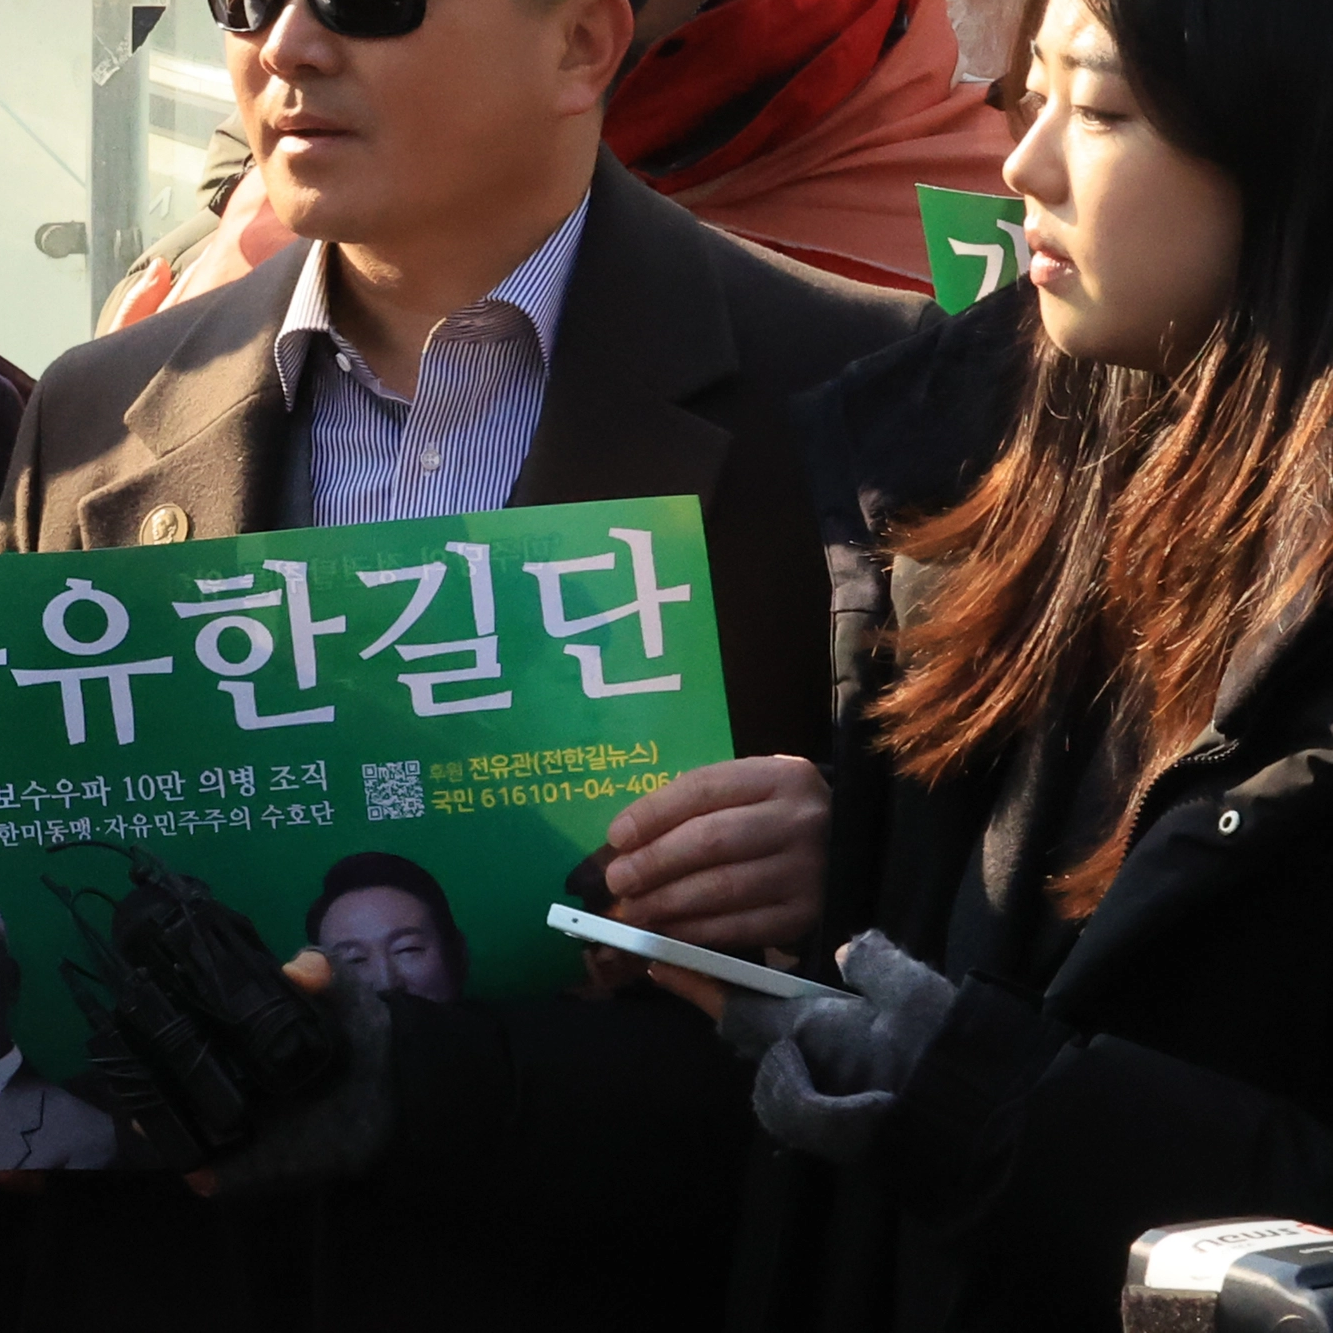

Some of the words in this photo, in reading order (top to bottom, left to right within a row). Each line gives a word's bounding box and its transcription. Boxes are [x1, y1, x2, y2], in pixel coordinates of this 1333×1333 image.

[123, 770, 186, 803] 10만
[199, 766, 255, 798] 의병
[270, 760, 328, 791] 조직
[431, 789, 475, 815] 국민
[481, 770, 682, 809] 616101-04-406
[260, 801, 335, 830] 수호단
